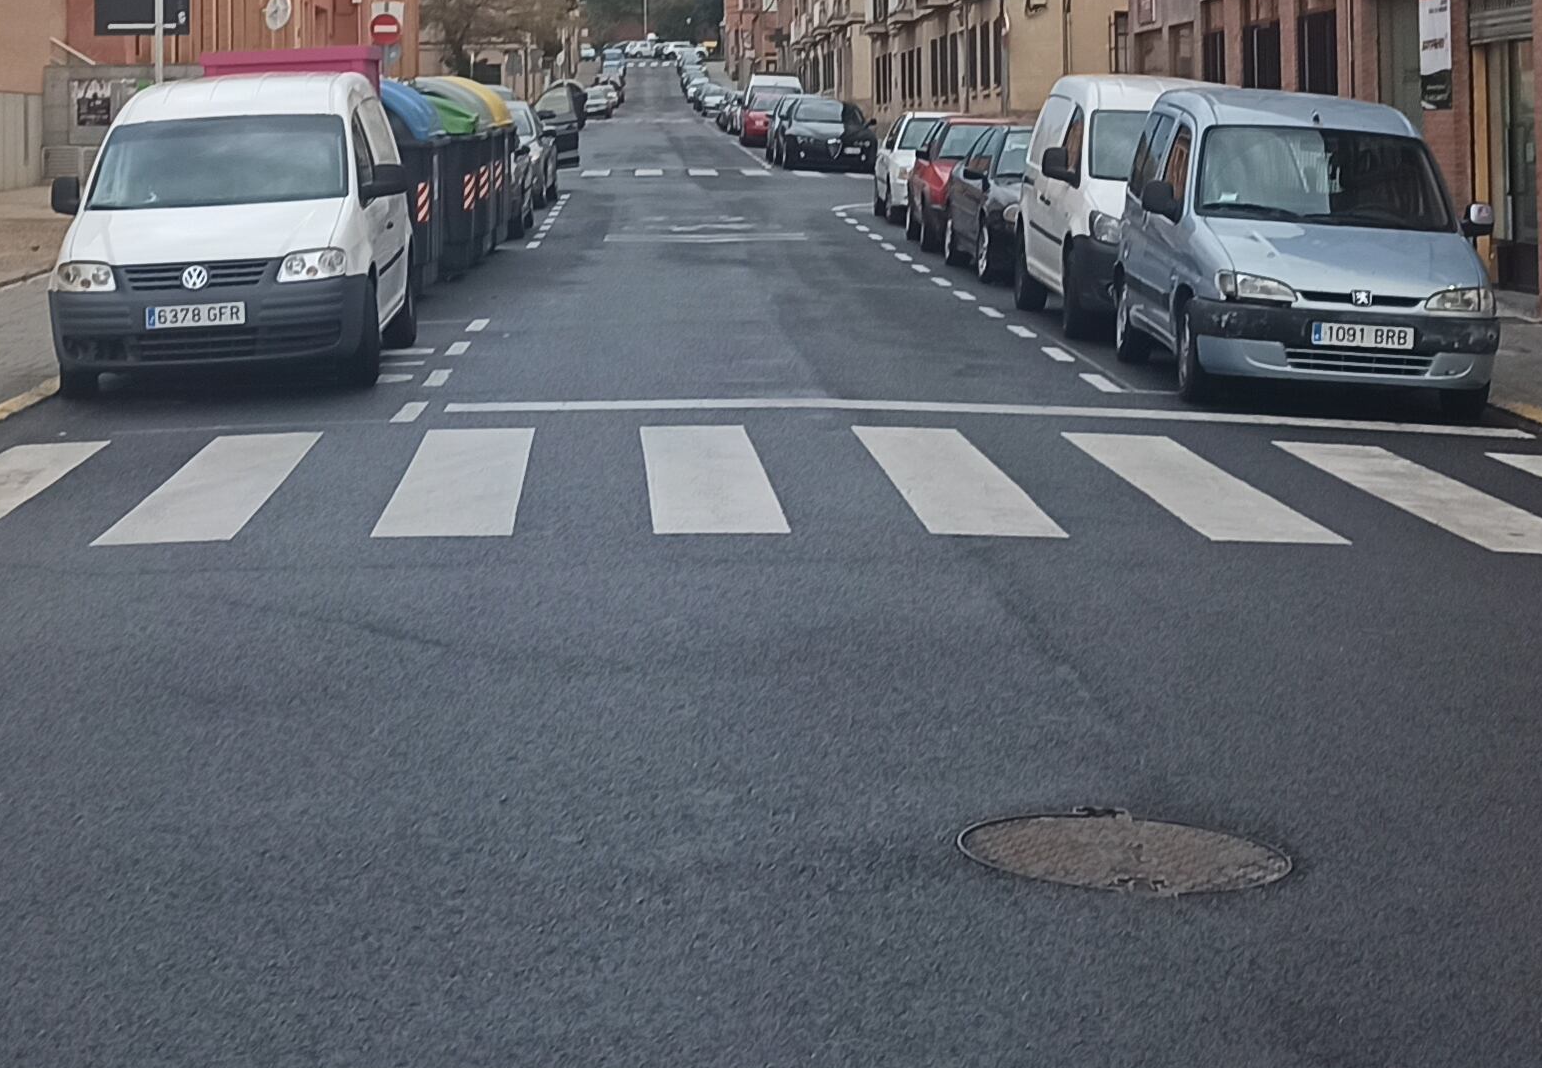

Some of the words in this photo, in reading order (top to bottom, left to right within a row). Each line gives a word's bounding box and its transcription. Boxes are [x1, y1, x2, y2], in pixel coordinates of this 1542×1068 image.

[158, 307, 201, 324] 6378
[207, 305, 240, 322] GFR
[1328, 326, 1365, 343] 1091
[1374, 328, 1408, 346] BRB
